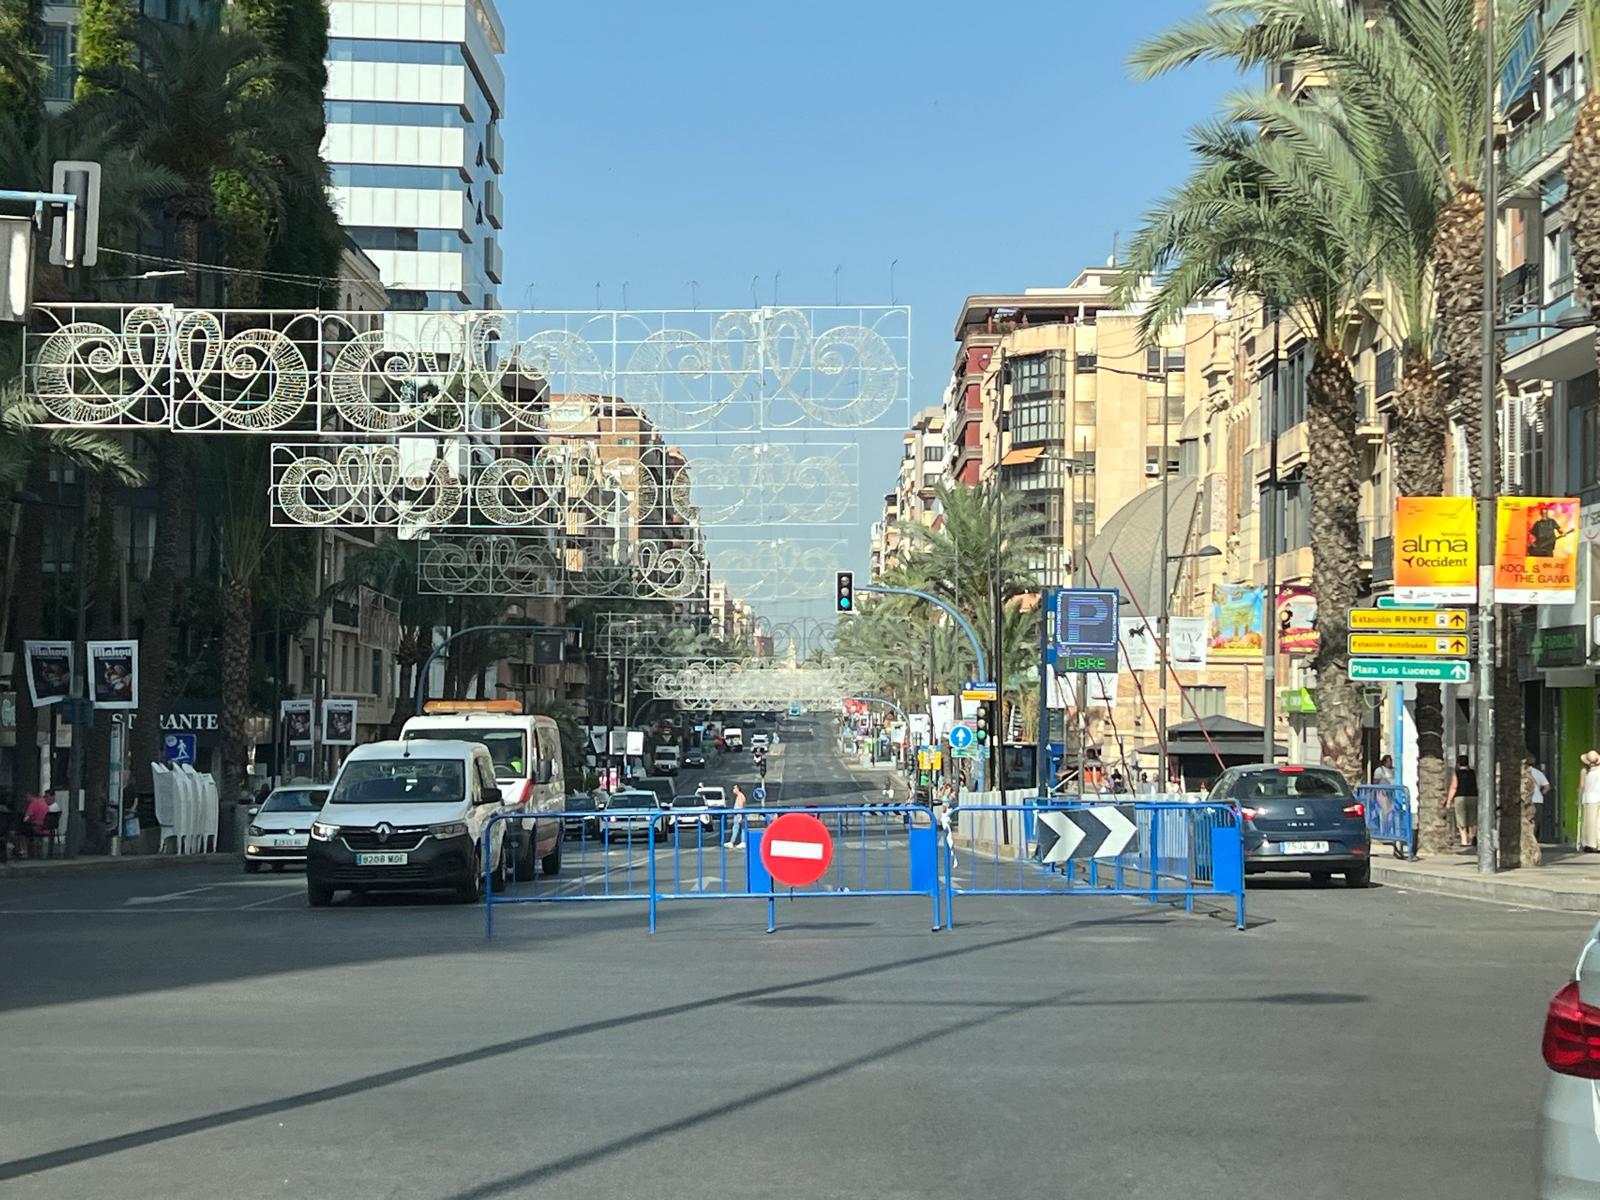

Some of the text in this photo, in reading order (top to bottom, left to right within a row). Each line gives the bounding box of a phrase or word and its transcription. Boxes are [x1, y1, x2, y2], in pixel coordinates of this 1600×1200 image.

[1402, 534, 1469, 553] alma
[1416, 556, 1468, 567] Occident
[1514, 574, 1535, 583] THE
[1395, 615, 1430, 625] RENFE
[1066, 657, 1107, 669] LIBRE
[1352, 665, 1441, 677] Plaza Los Luceros
